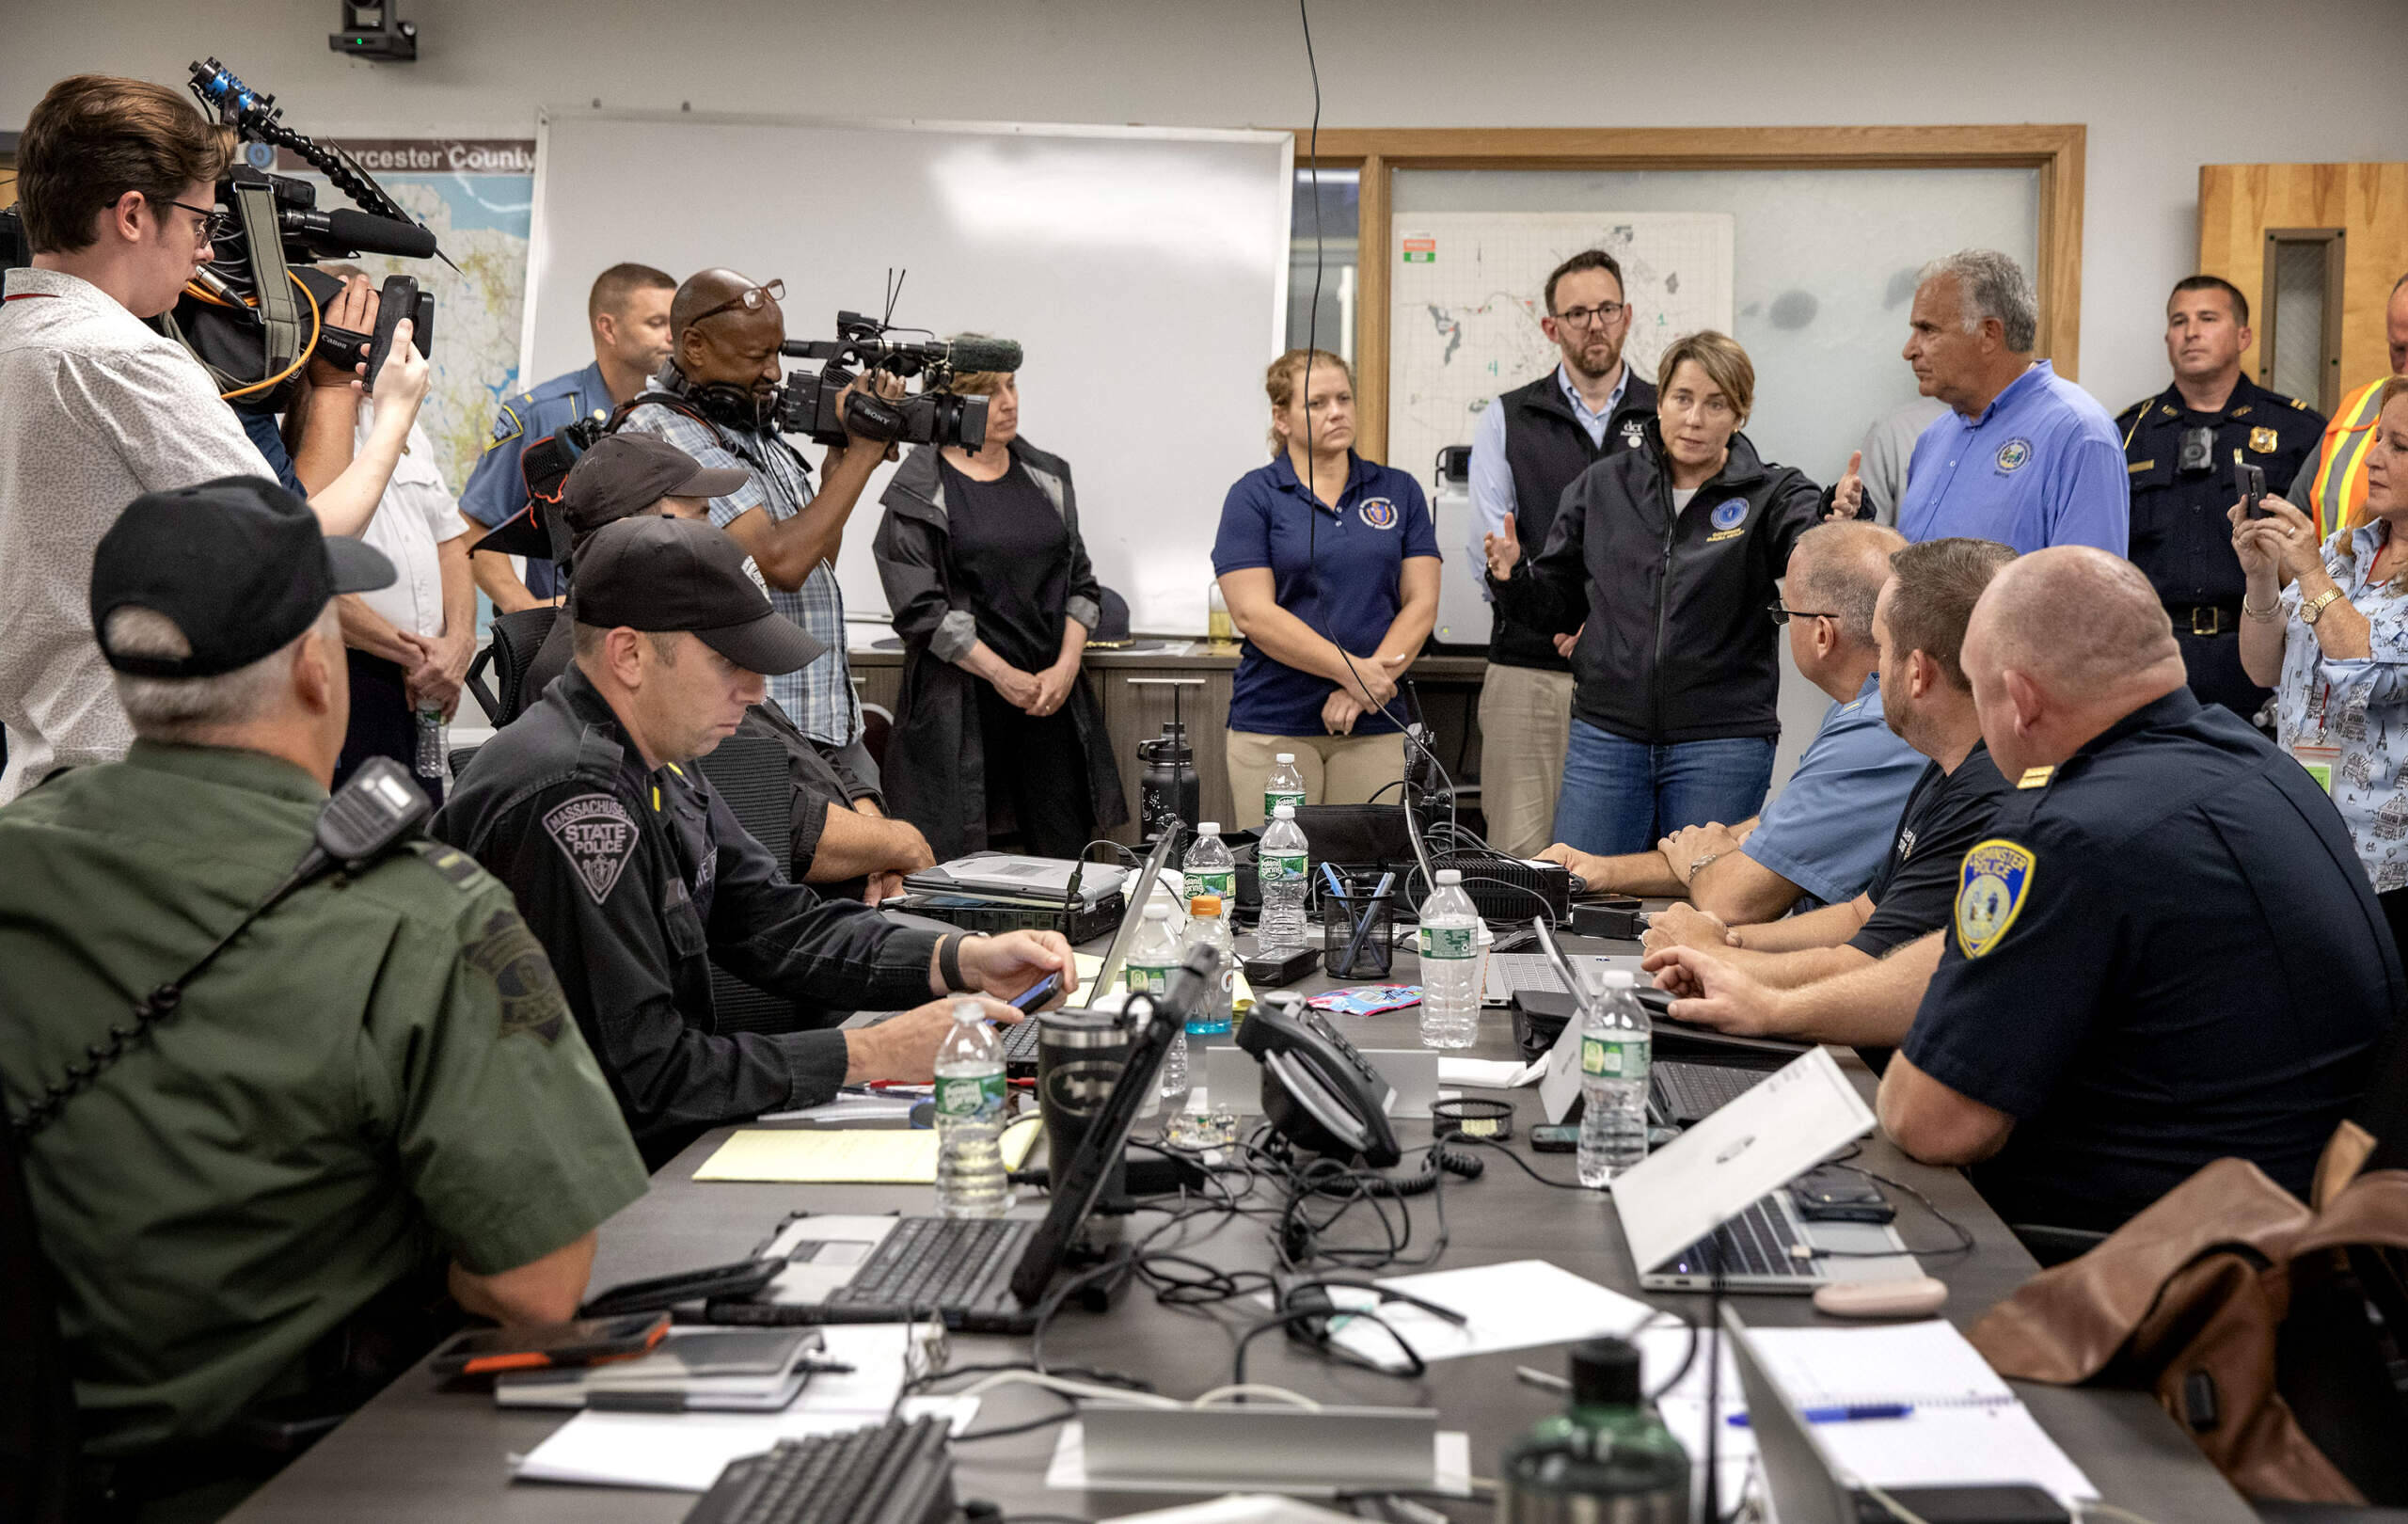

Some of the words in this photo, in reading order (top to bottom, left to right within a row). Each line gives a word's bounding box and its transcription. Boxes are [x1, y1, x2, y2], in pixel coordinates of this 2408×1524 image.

[325, 145, 443, 169] orcester
[448, 144, 534, 173] County
[322, 334, 347, 349] Canon
[864, 407, 891, 424] SONY
[564, 822, 626, 842] STATE
[574, 839, 624, 854] POLICE
[1972, 858, 2012, 880] POLICE
